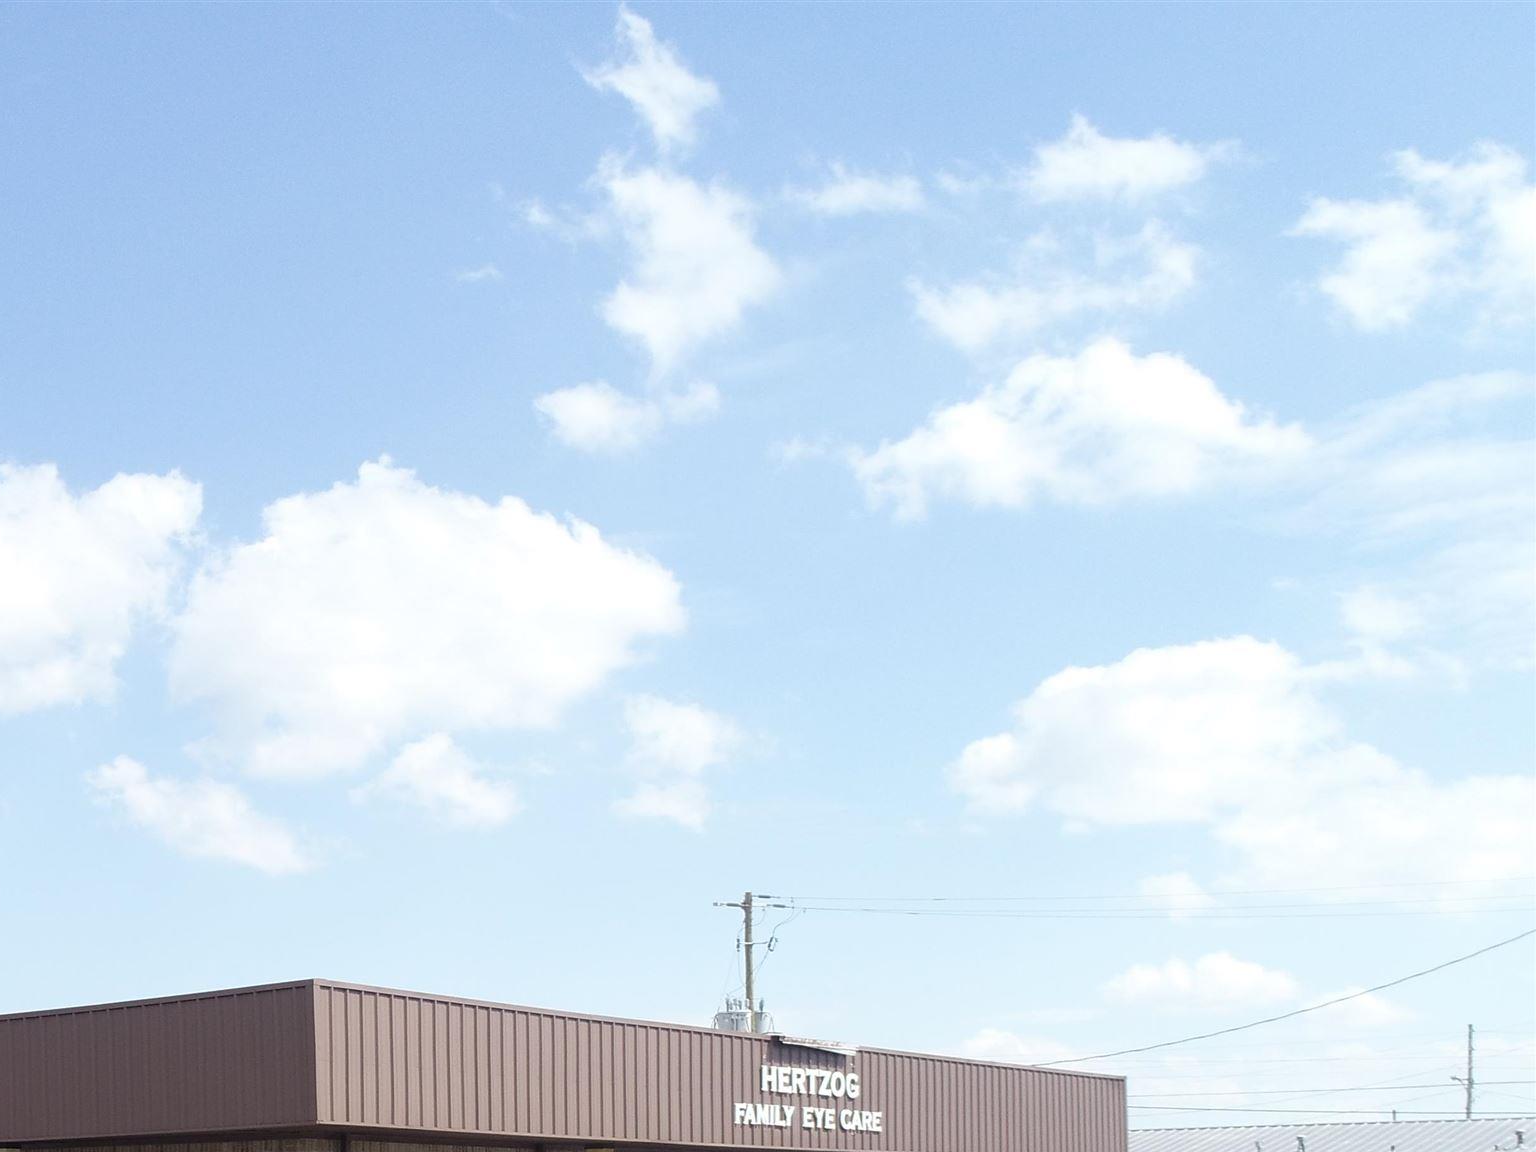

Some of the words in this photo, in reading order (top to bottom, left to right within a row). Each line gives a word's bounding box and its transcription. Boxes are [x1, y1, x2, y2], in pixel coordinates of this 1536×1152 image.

[761, 1064, 860, 1099] HERTZOG
[734, 1102, 795, 1127] FAMILY
[802, 1106, 836, 1130] EYE
[840, 1109, 883, 1132] CARE
